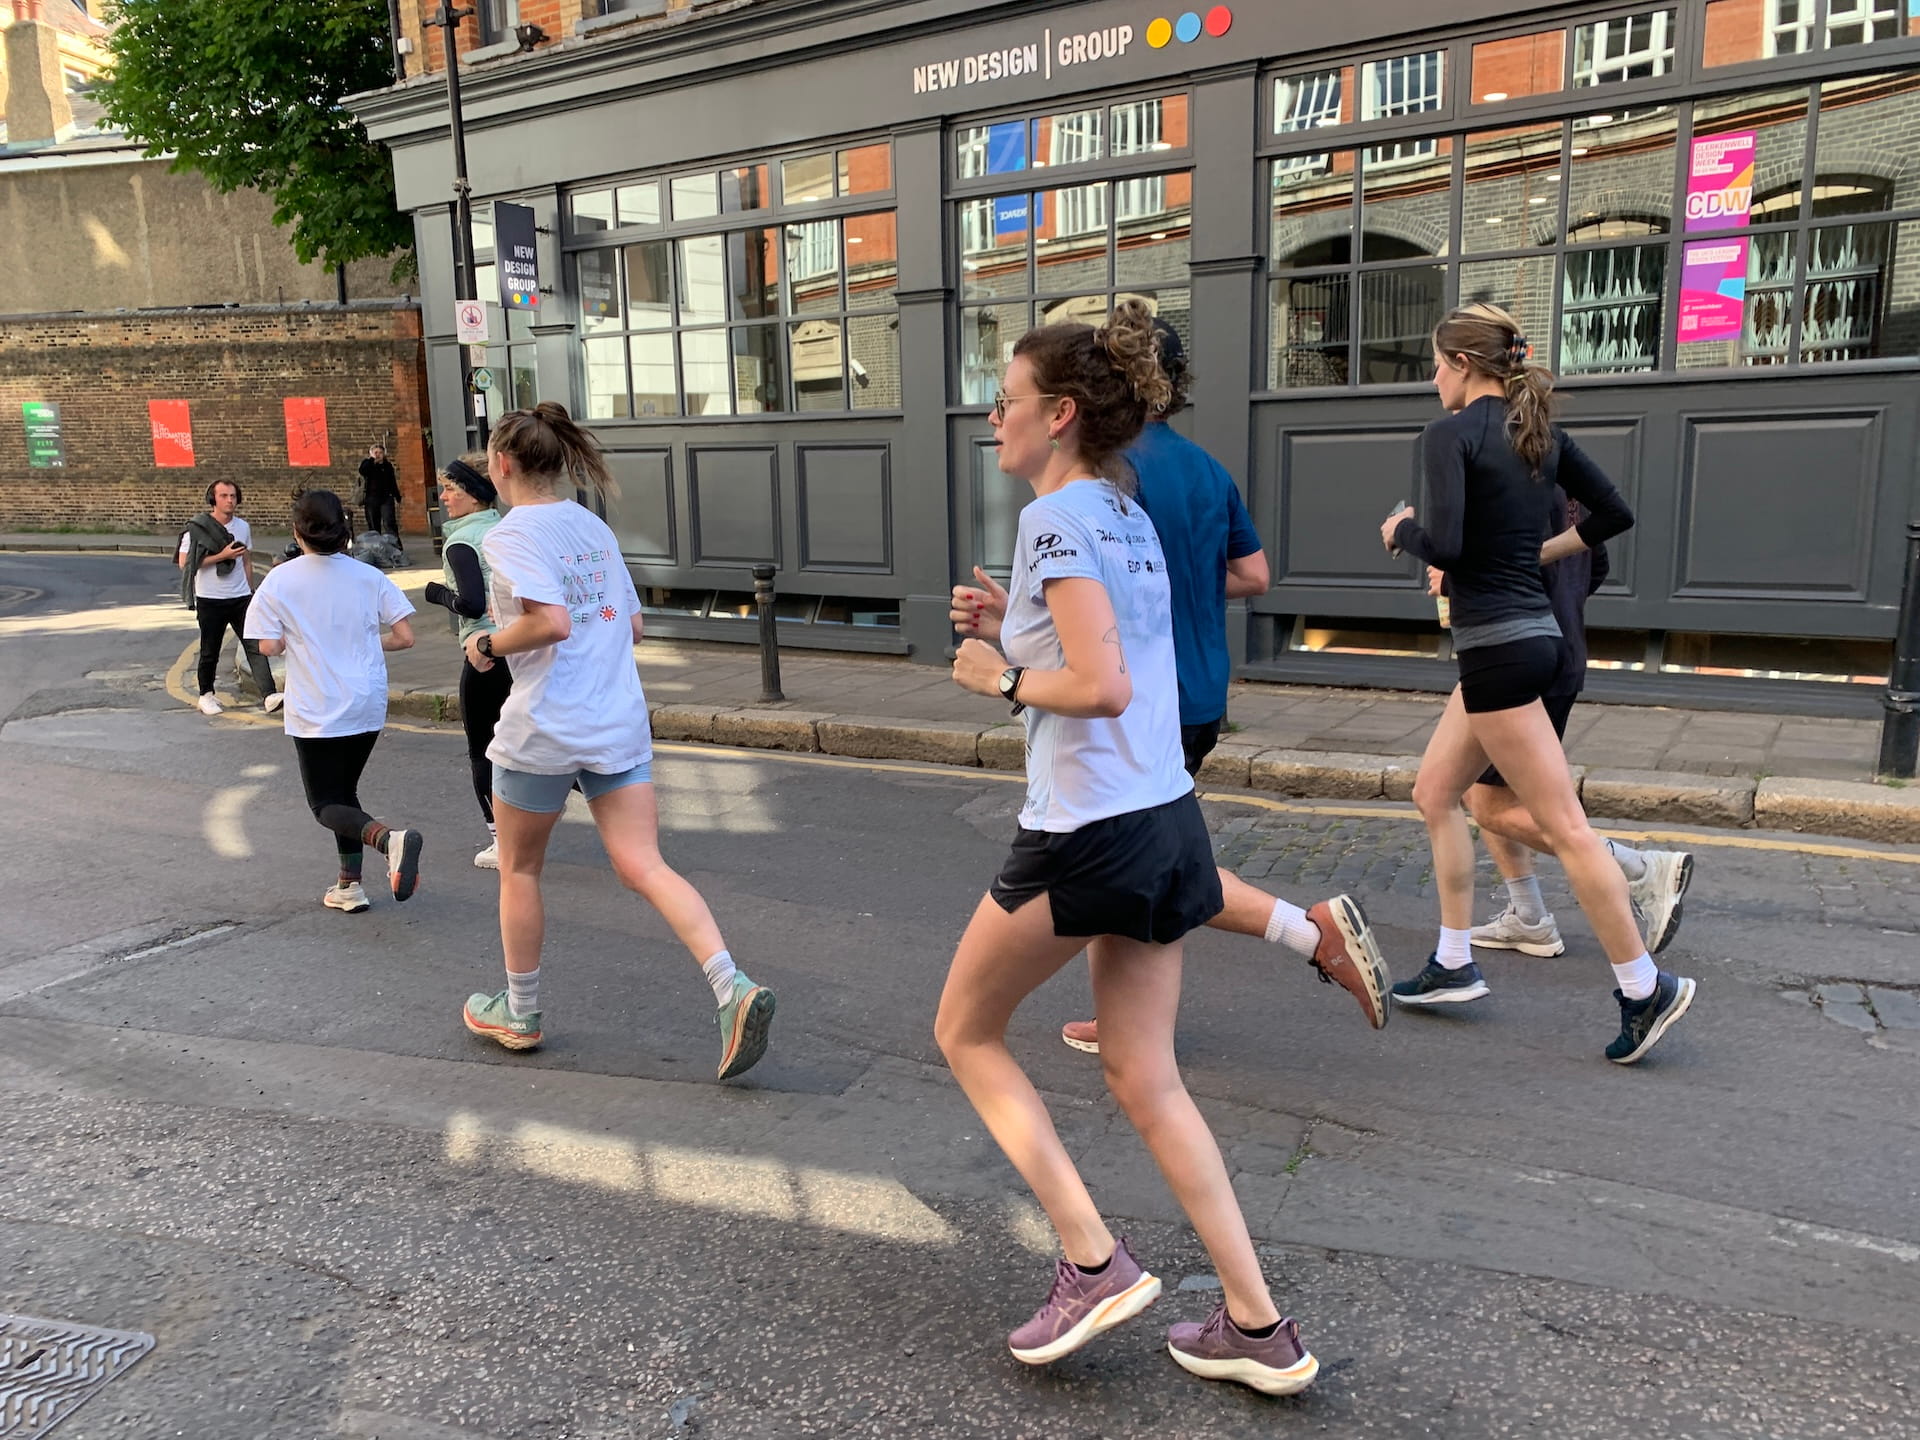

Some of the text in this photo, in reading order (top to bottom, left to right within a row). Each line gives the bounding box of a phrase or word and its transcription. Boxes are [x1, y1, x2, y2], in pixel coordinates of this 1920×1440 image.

[913, 25, 1133, 94] NEW DESIGN GROUP
[1686, 188, 1751, 218] CDW
[513, 244, 534, 260] NEW
[504, 260, 535, 276] DESIGN
[507, 276, 536, 292] GROUP
[1029, 549, 1077, 572] HYUNDAI
